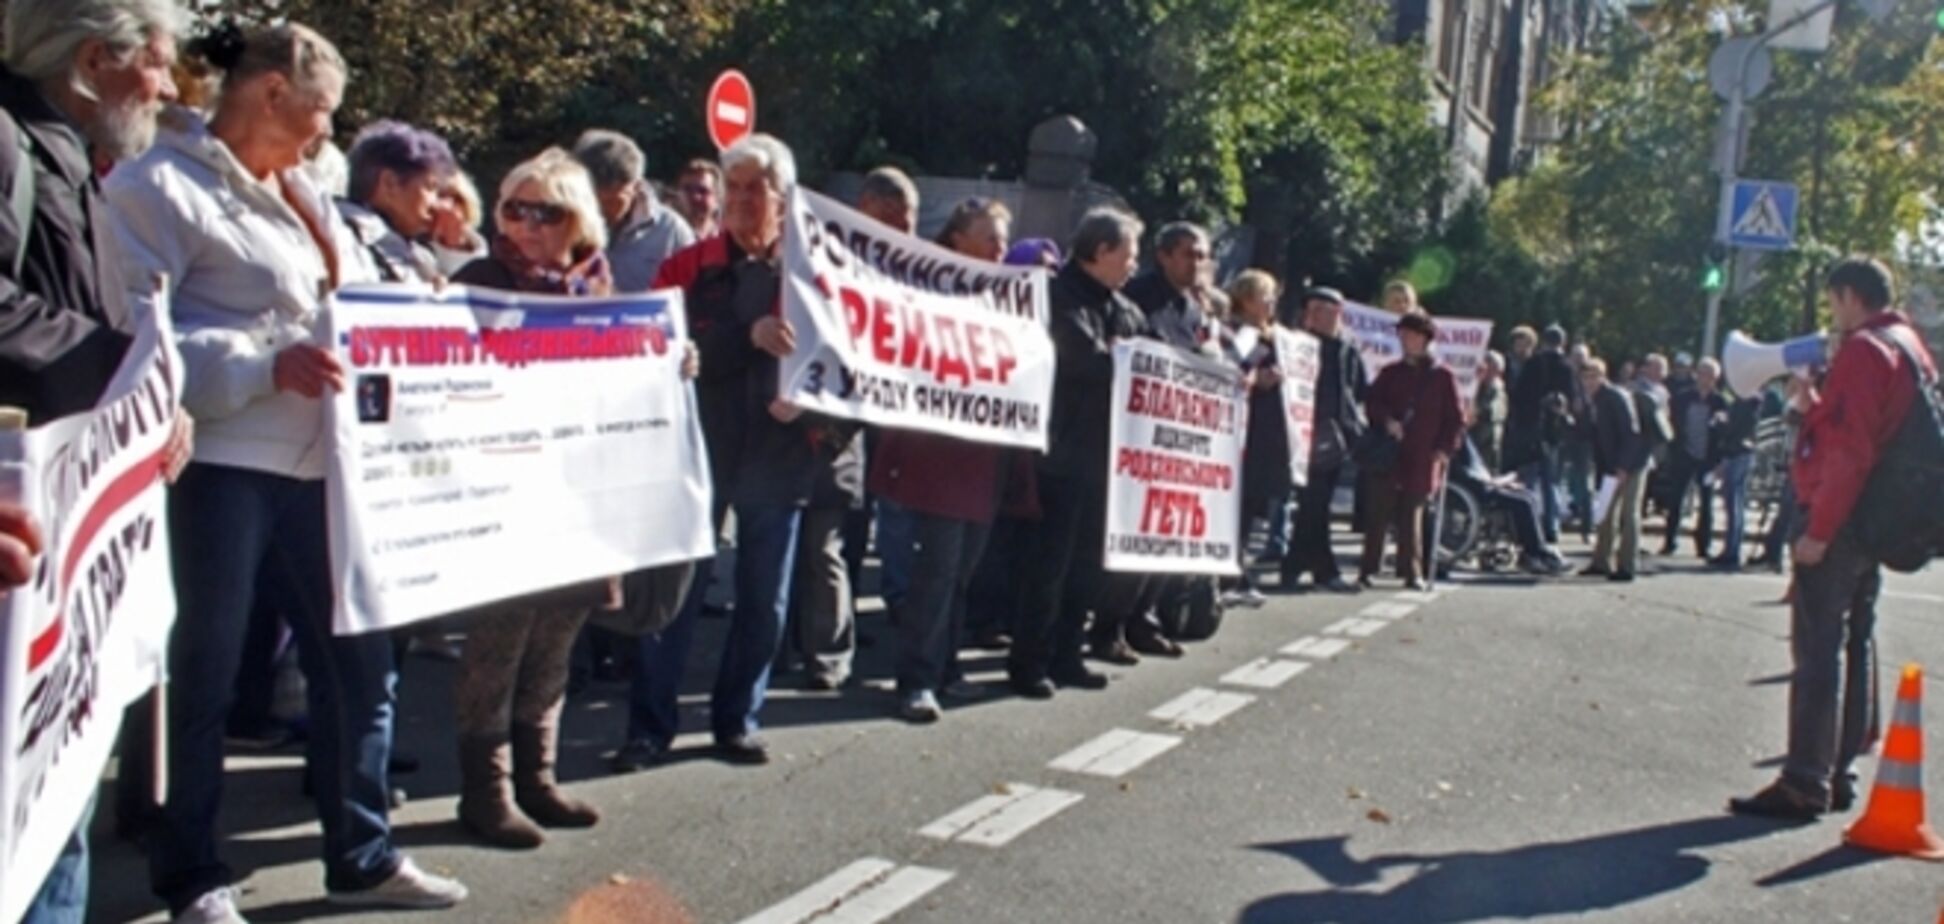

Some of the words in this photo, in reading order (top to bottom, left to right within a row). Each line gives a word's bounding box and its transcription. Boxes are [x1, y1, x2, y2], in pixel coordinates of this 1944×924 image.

[806, 360, 825, 396] З
[913, 384, 1040, 432] ЯНУКОВИЧА
[1140, 486, 1206, 538] ГЕТЬ
